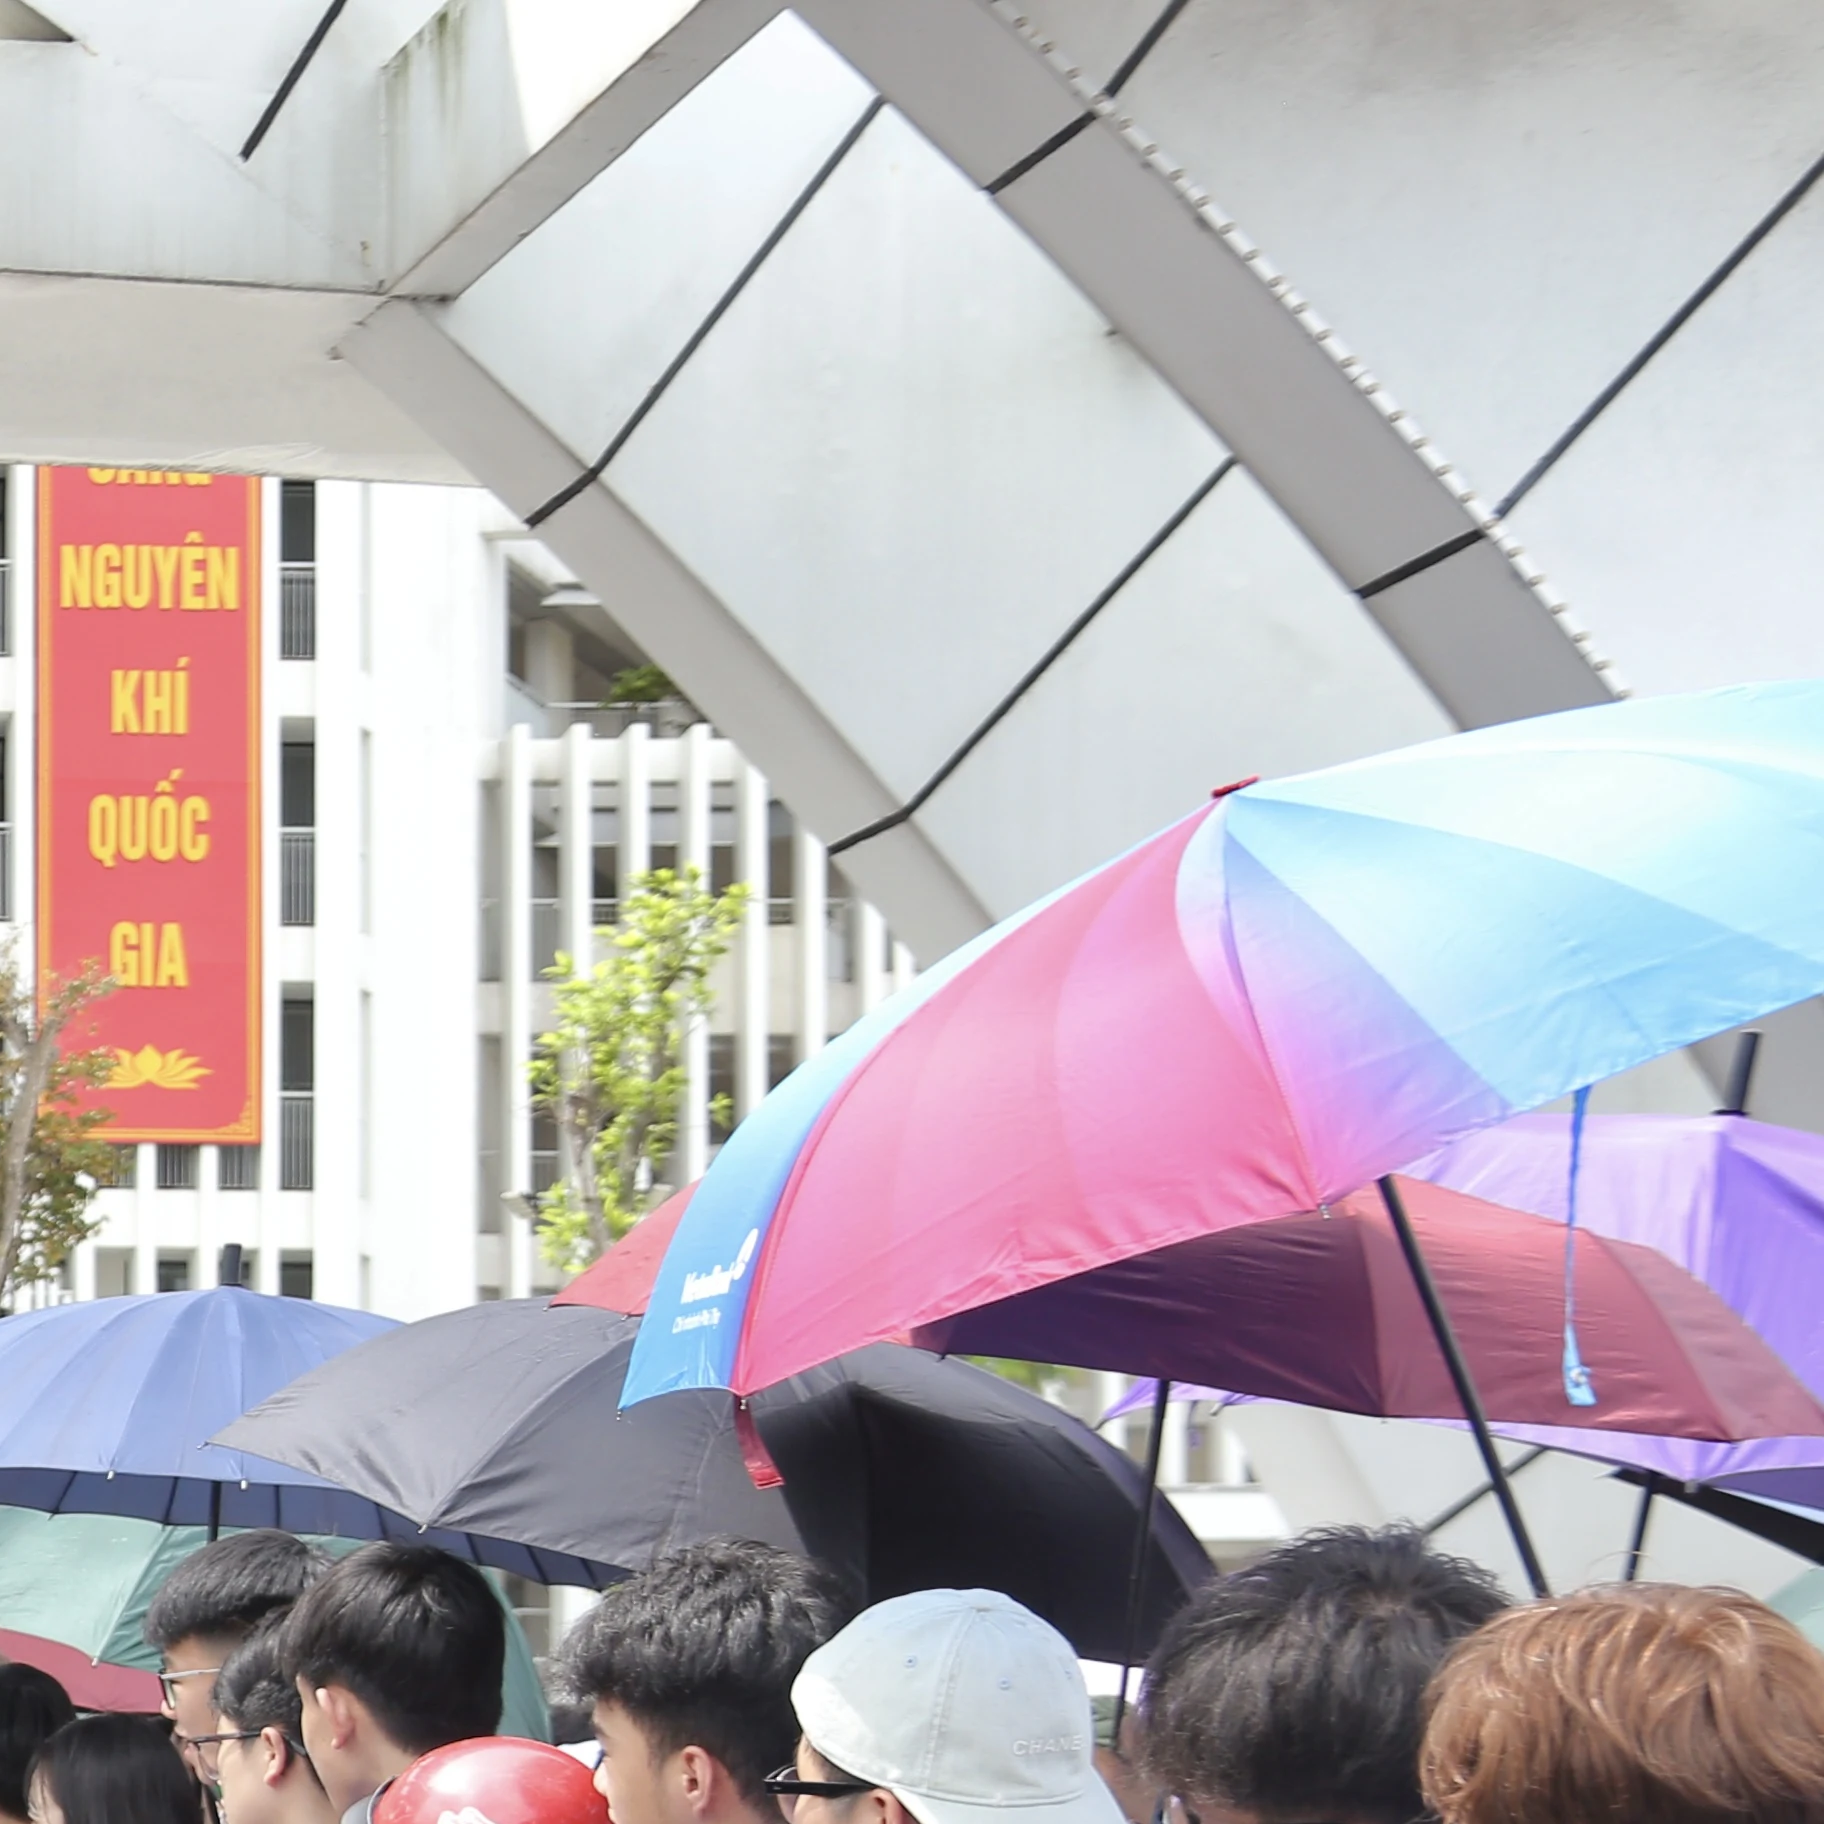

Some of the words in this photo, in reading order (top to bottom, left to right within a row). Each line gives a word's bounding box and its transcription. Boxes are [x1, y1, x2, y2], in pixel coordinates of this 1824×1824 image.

[60, 530, 240, 611] NGUYÊN
[110, 656, 191, 735] KHÍ
[88, 768, 210, 868] QUỐC
[109, 920, 189, 988] GIA
